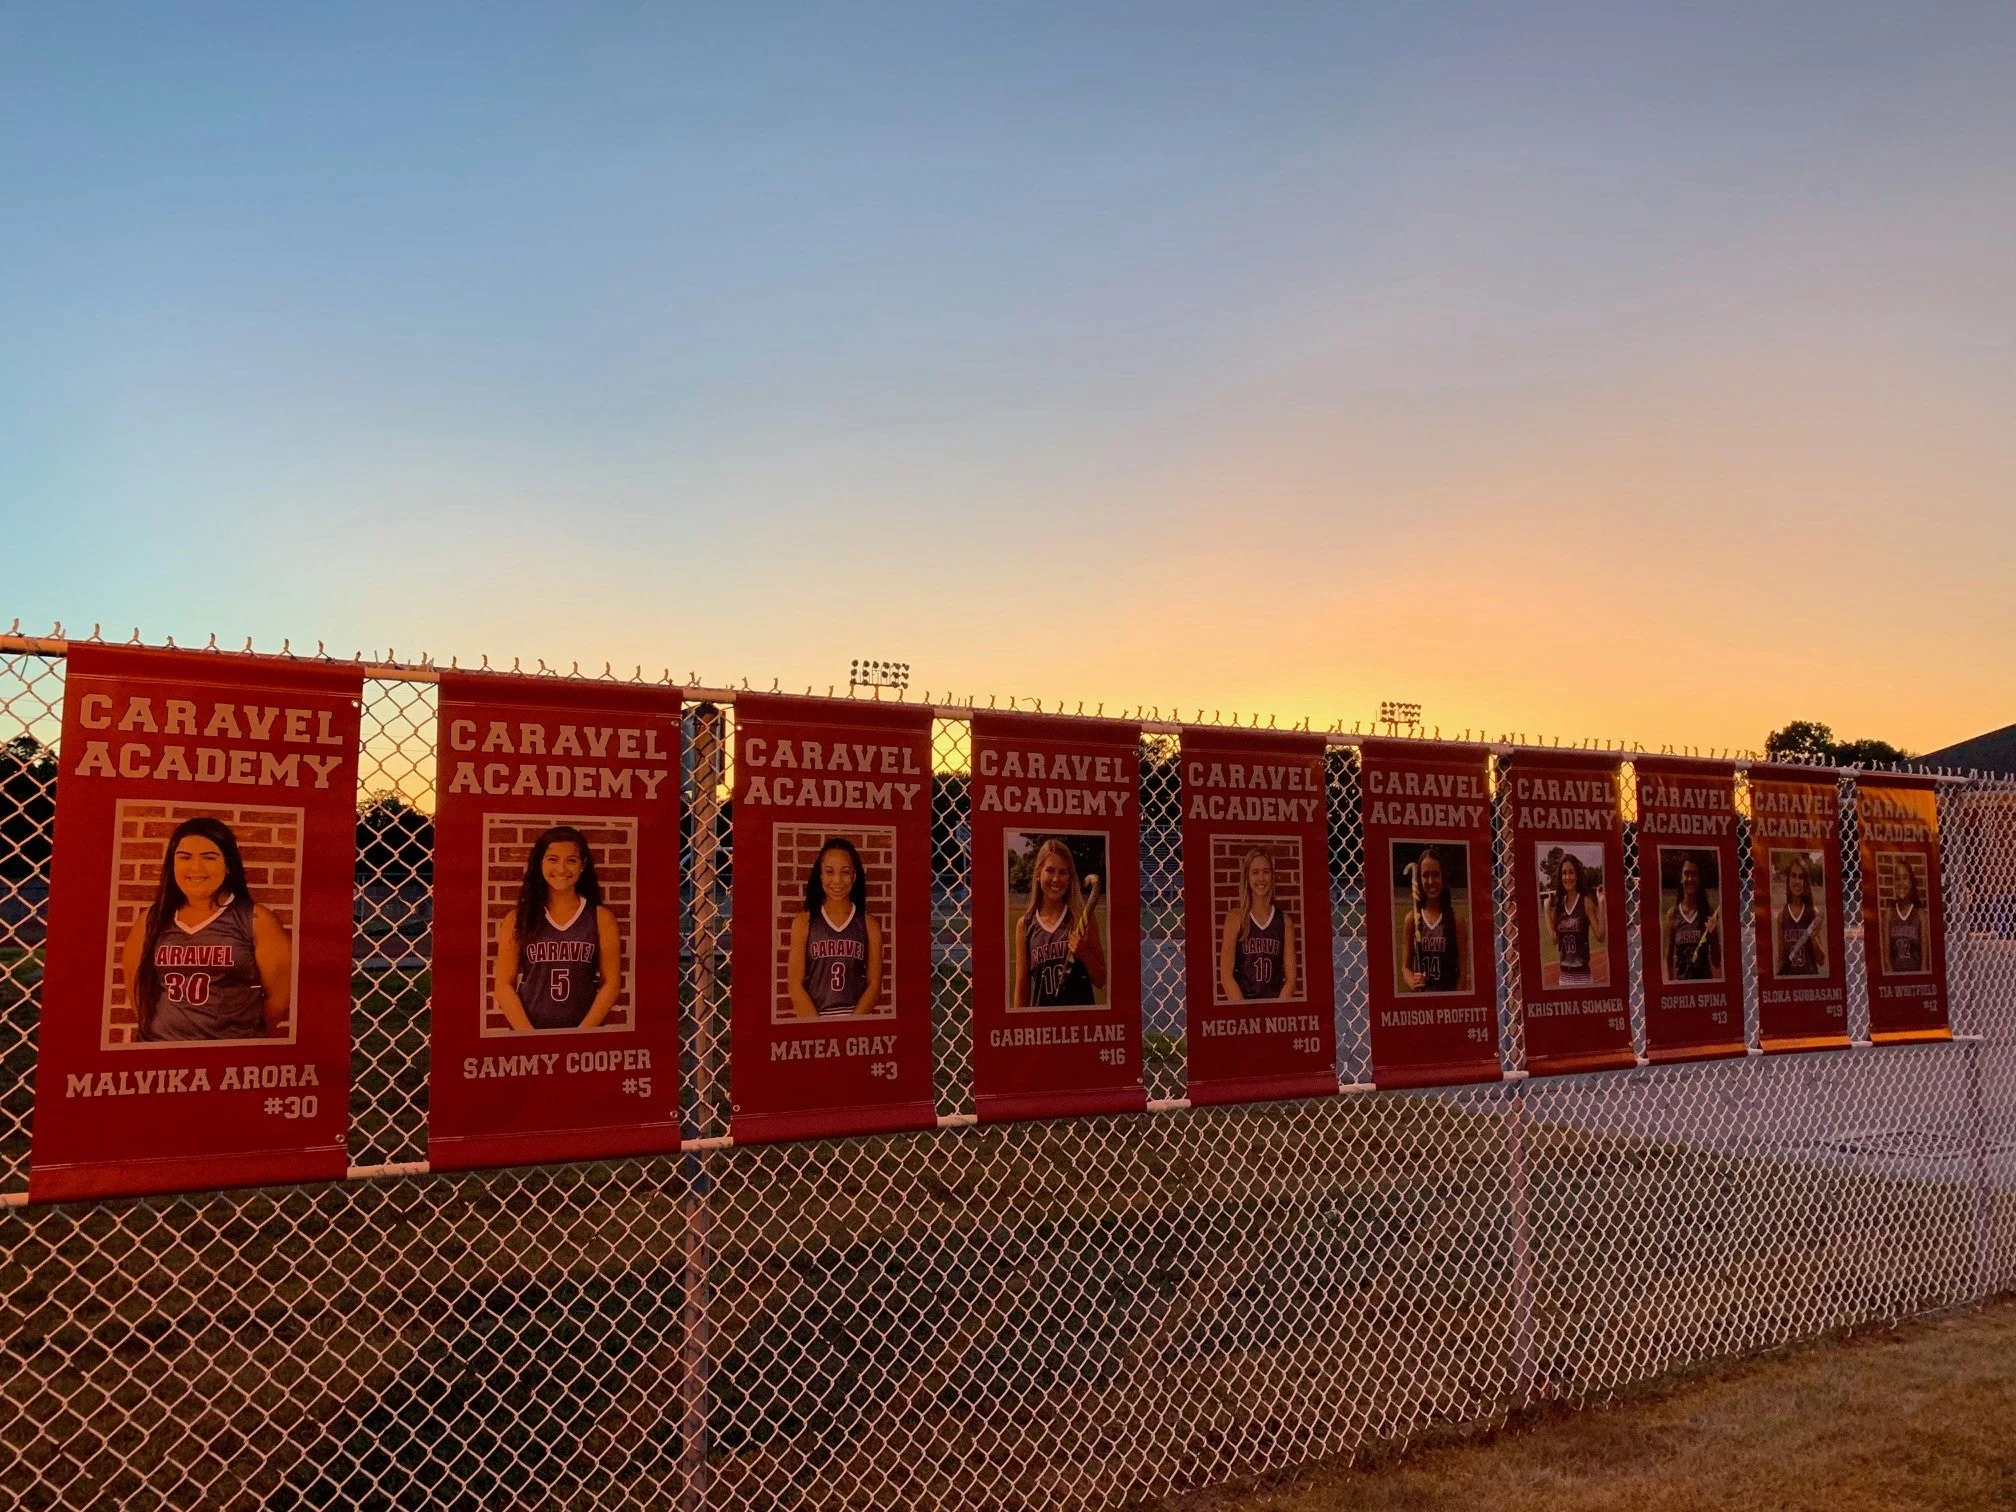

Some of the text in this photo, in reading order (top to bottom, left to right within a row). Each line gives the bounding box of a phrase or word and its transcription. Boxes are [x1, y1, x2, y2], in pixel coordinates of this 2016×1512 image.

[79, 694, 343, 745] CARAVEL
[451, 719, 667, 760] CARAVEL
[75, 741, 342, 788] ACADEMY
[745, 738, 920, 775] CARAVEL
[980, 750, 1129, 783] CARAVEL
[449, 762, 667, 799] ACADEMY
[1188, 762, 1317, 791] CARAVEL
[1369, 771, 1483, 798] CARAVEL
[744, 776, 920, 810] ACADEMY
[980, 784, 1130, 816] ACADEMY
[1517, 778, 1615, 802] CARAVEL
[1642, 786, 1730, 810] CARAVEL
[1188, 795, 1318, 822] ACADEMY
[1370, 801, 1483, 827] ACADEMY
[1755, 792, 1833, 814] CARAVEL
[1519, 807, 1616, 830] ACADEMY
[1643, 813, 1731, 835] ACADEMY
[1755, 818, 1834, 839] ACADEMY
[155, 945, 234, 967] ARAVEL
[1422, 956, 1441, 980] 14
[831, 962, 845, 991] 3
[1254, 957, 1272, 983] 10
[165, 972, 211, 1006] 30
[550, 969, 570, 1001] 5
[1527, 998, 1623, 1017] KRISTINA SOMMER
[1661, 993, 1727, 1010] SOPHIA SPINA
[1202, 1015, 1320, 1036] MEGAN NORTH
[1381, 1007, 1488, 1027] MADISON PROFFITT
[1712, 1011, 1728, 1024] #13
[990, 1024, 1125, 1047] GABRIELLE LANE
[1293, 1037, 1320, 1053] #10
[1467, 1027, 1489, 1042] #14
[770, 1035, 897, 1061] MATEA GRAY
[1099, 1048, 1126, 1065] #16
[463, 1049, 651, 1079] SAMMY COOPER
[870, 1061, 898, 1080] #3
[66, 1064, 319, 1098] MALVIKA ARORA
[622, 1077, 651, 1098] #5
[264, 1096, 318, 1118] #30
